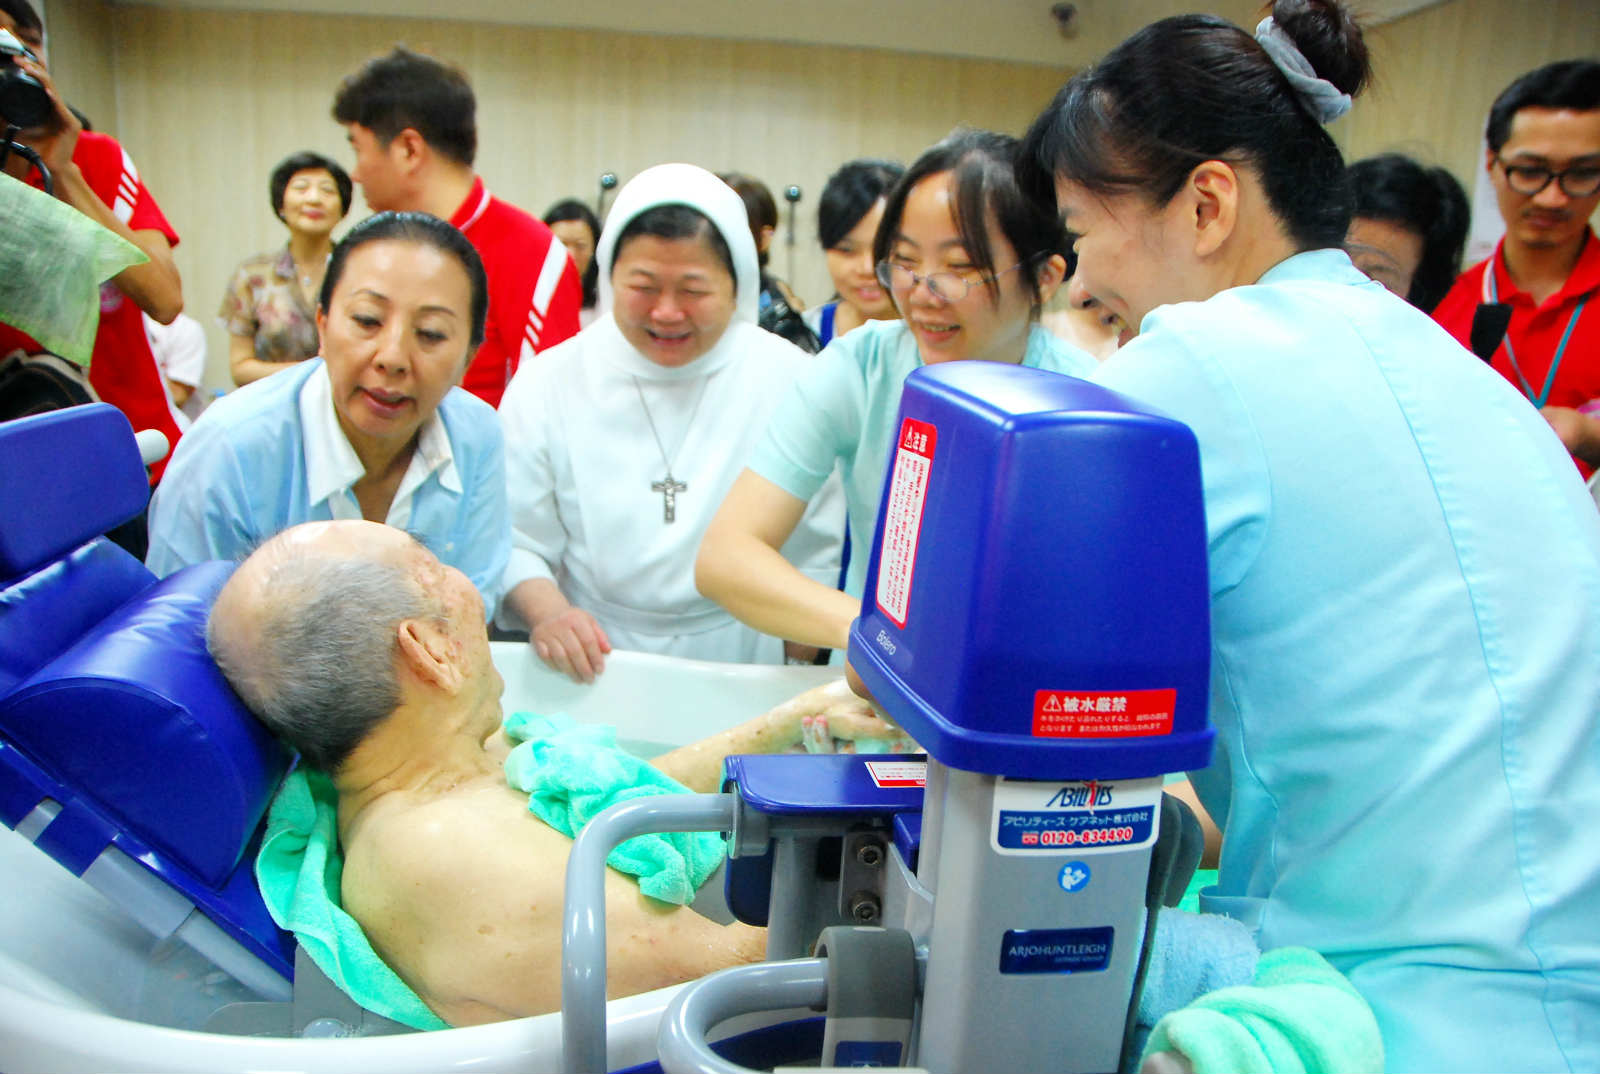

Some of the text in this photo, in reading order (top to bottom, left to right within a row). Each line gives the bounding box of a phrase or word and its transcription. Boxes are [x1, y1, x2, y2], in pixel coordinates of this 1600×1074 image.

[1063, 696, 1127, 713] 被水厳禁
[1041, 827, 1133, 846] 0120-834490
[1009, 944, 1106, 957] ARJOHUNTLEIGH
